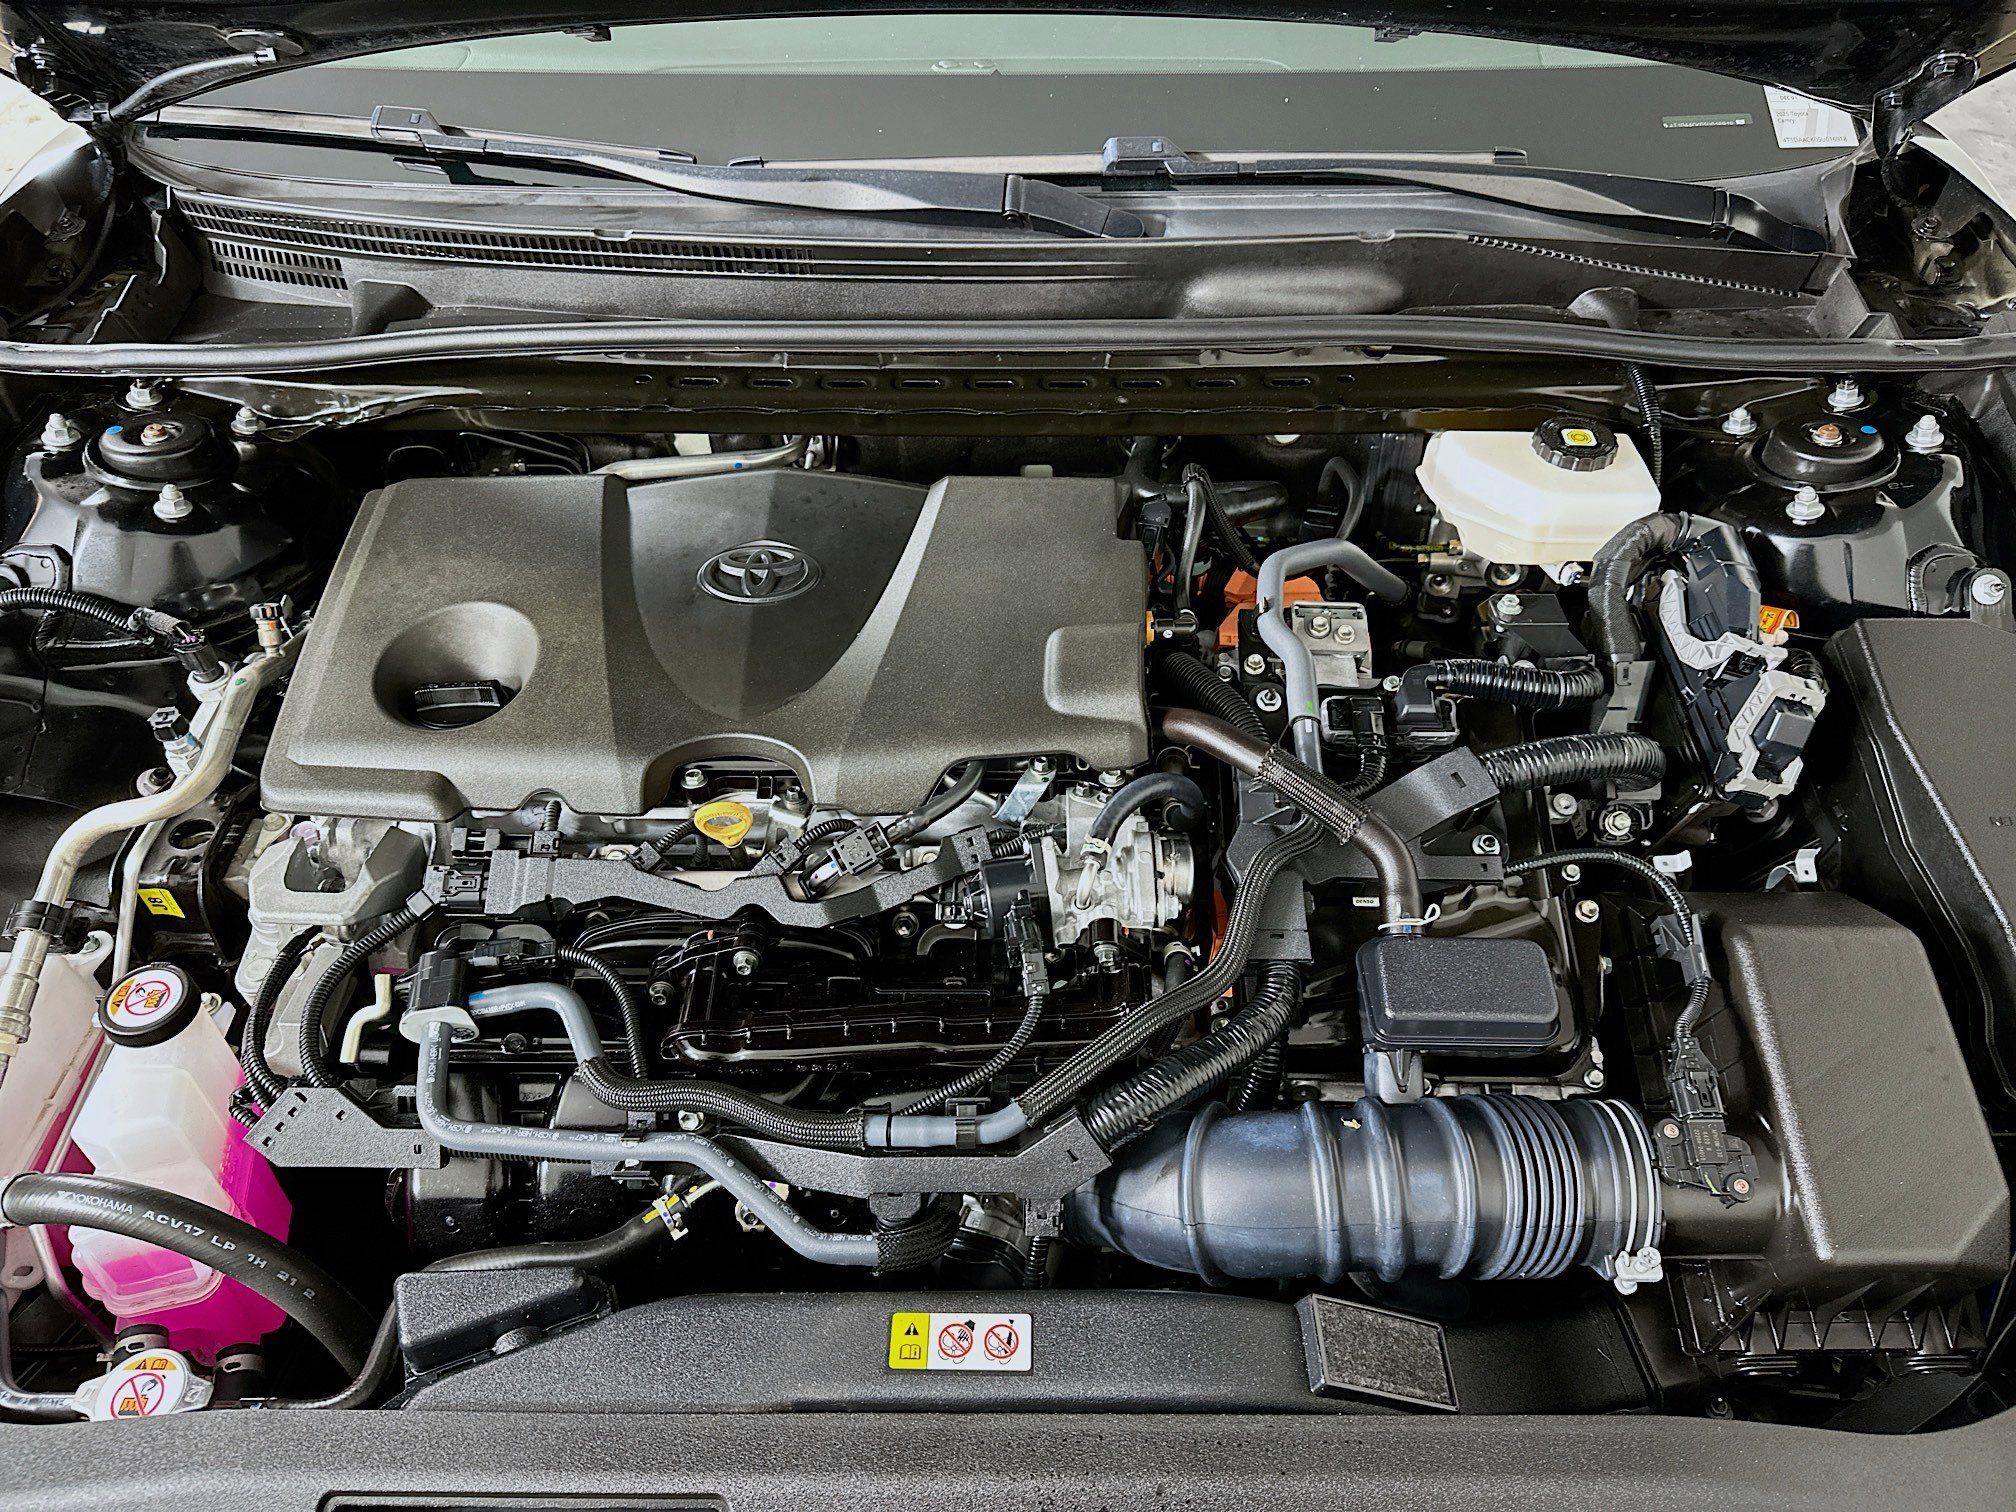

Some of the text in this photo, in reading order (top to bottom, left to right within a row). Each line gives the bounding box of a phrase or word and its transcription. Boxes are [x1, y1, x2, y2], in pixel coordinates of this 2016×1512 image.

[71, 1193, 133, 1214] YOKOHAMA
[142, 1209, 205, 1237] ACV17
[211, 1235, 237, 1251] LP
